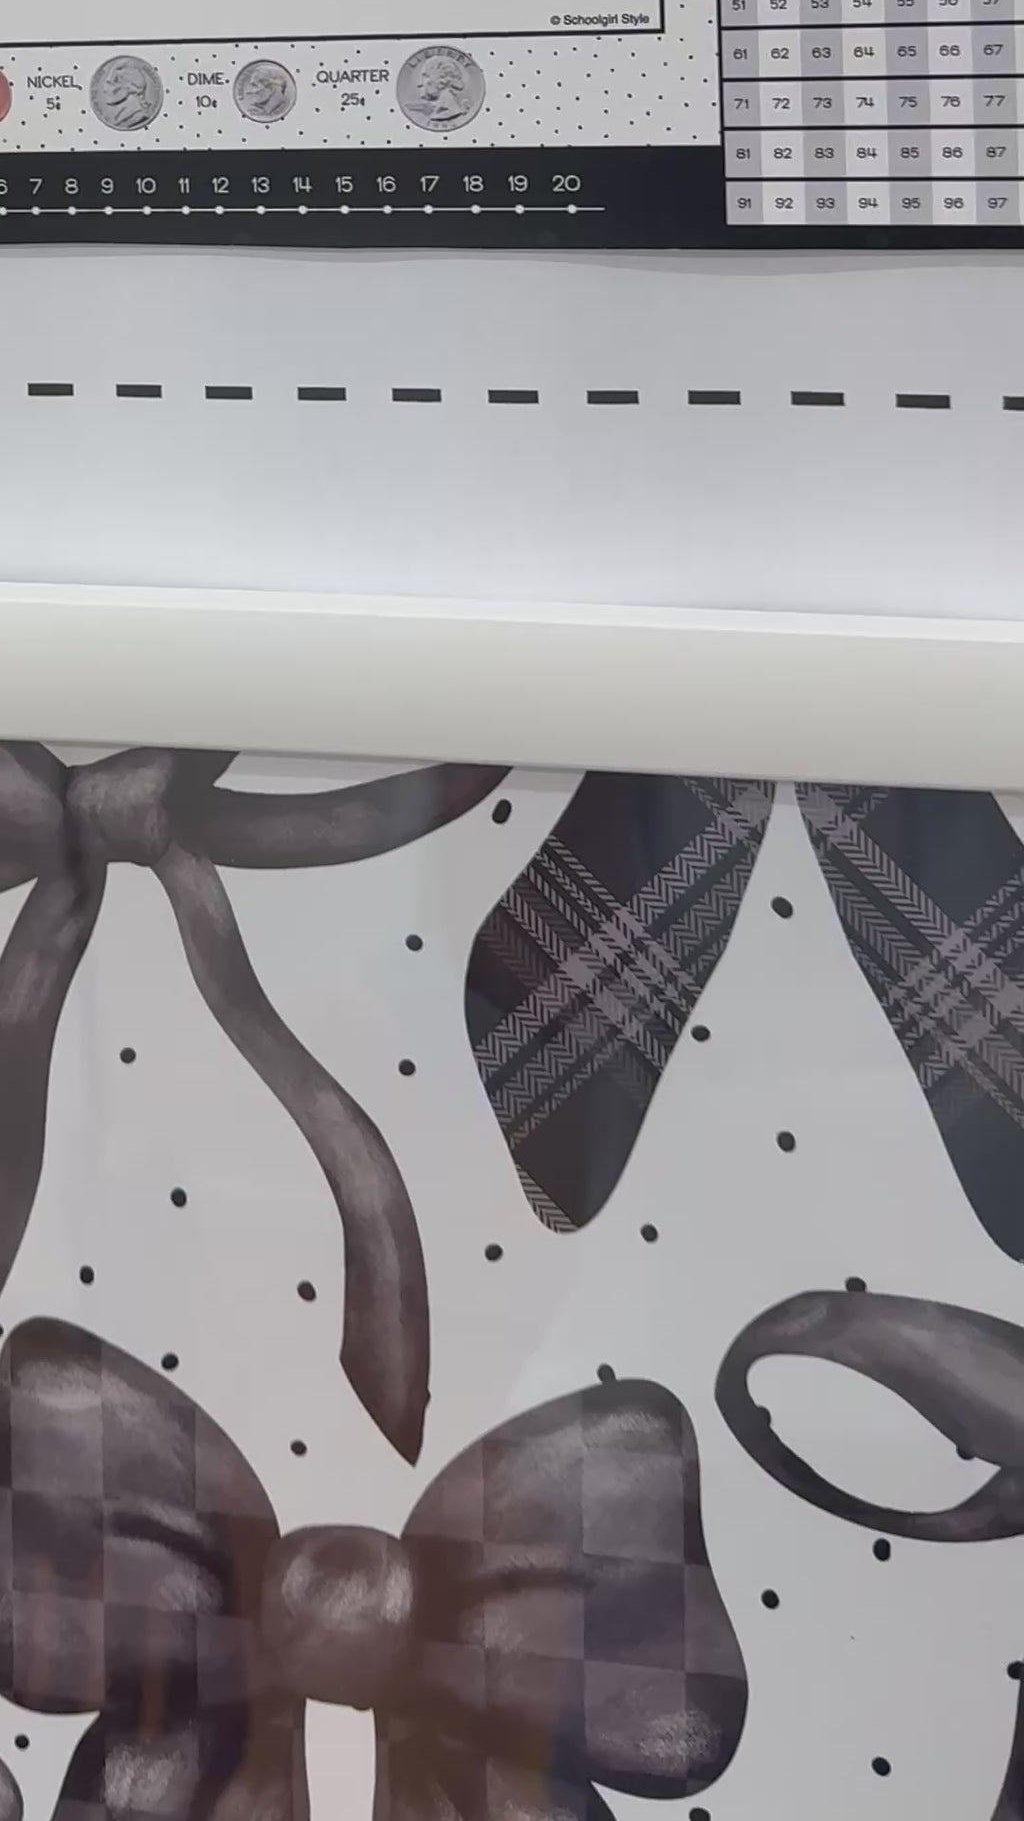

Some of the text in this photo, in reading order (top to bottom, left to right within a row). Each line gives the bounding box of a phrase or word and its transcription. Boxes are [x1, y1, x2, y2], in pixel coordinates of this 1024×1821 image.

[731, 0, 746, 12] 51
[563, 14, 617, 26] Schoolgirl
[621, 13, 649, 25] Style
[732, 43, 1004, 60] 61 62 63 64 65 66 67
[27, 75, 78, 88] NICKEL
[187, 72, 224, 85] DIME
[316, 69, 389, 83] QUARTER
[733, 94, 1006, 110] 71 72 73 74 75 76 77
[735, 146, 1007, 160] 81 82 83 84 85 86 87
[29, 178, 43, 195] 7
[65, 178, 79, 195] 8
[100, 177, 114, 194] 9
[136, 177, 157, 194] 10
[178, 177, 190, 193] 11
[212, 176, 229, 194] 12
[251, 176, 270, 194] 13
[293, 176, 312, 193] 14
[335, 176, 353, 193] 15
[376, 175, 396, 193] 16
[420, 175, 440, 192] 17
[463, 175, 484, 192] 18
[508, 175, 528, 192] 19
[552, 174, 581, 192] 20
[737, 197, 1009, 210] 91 92 93 94 95 96 97
